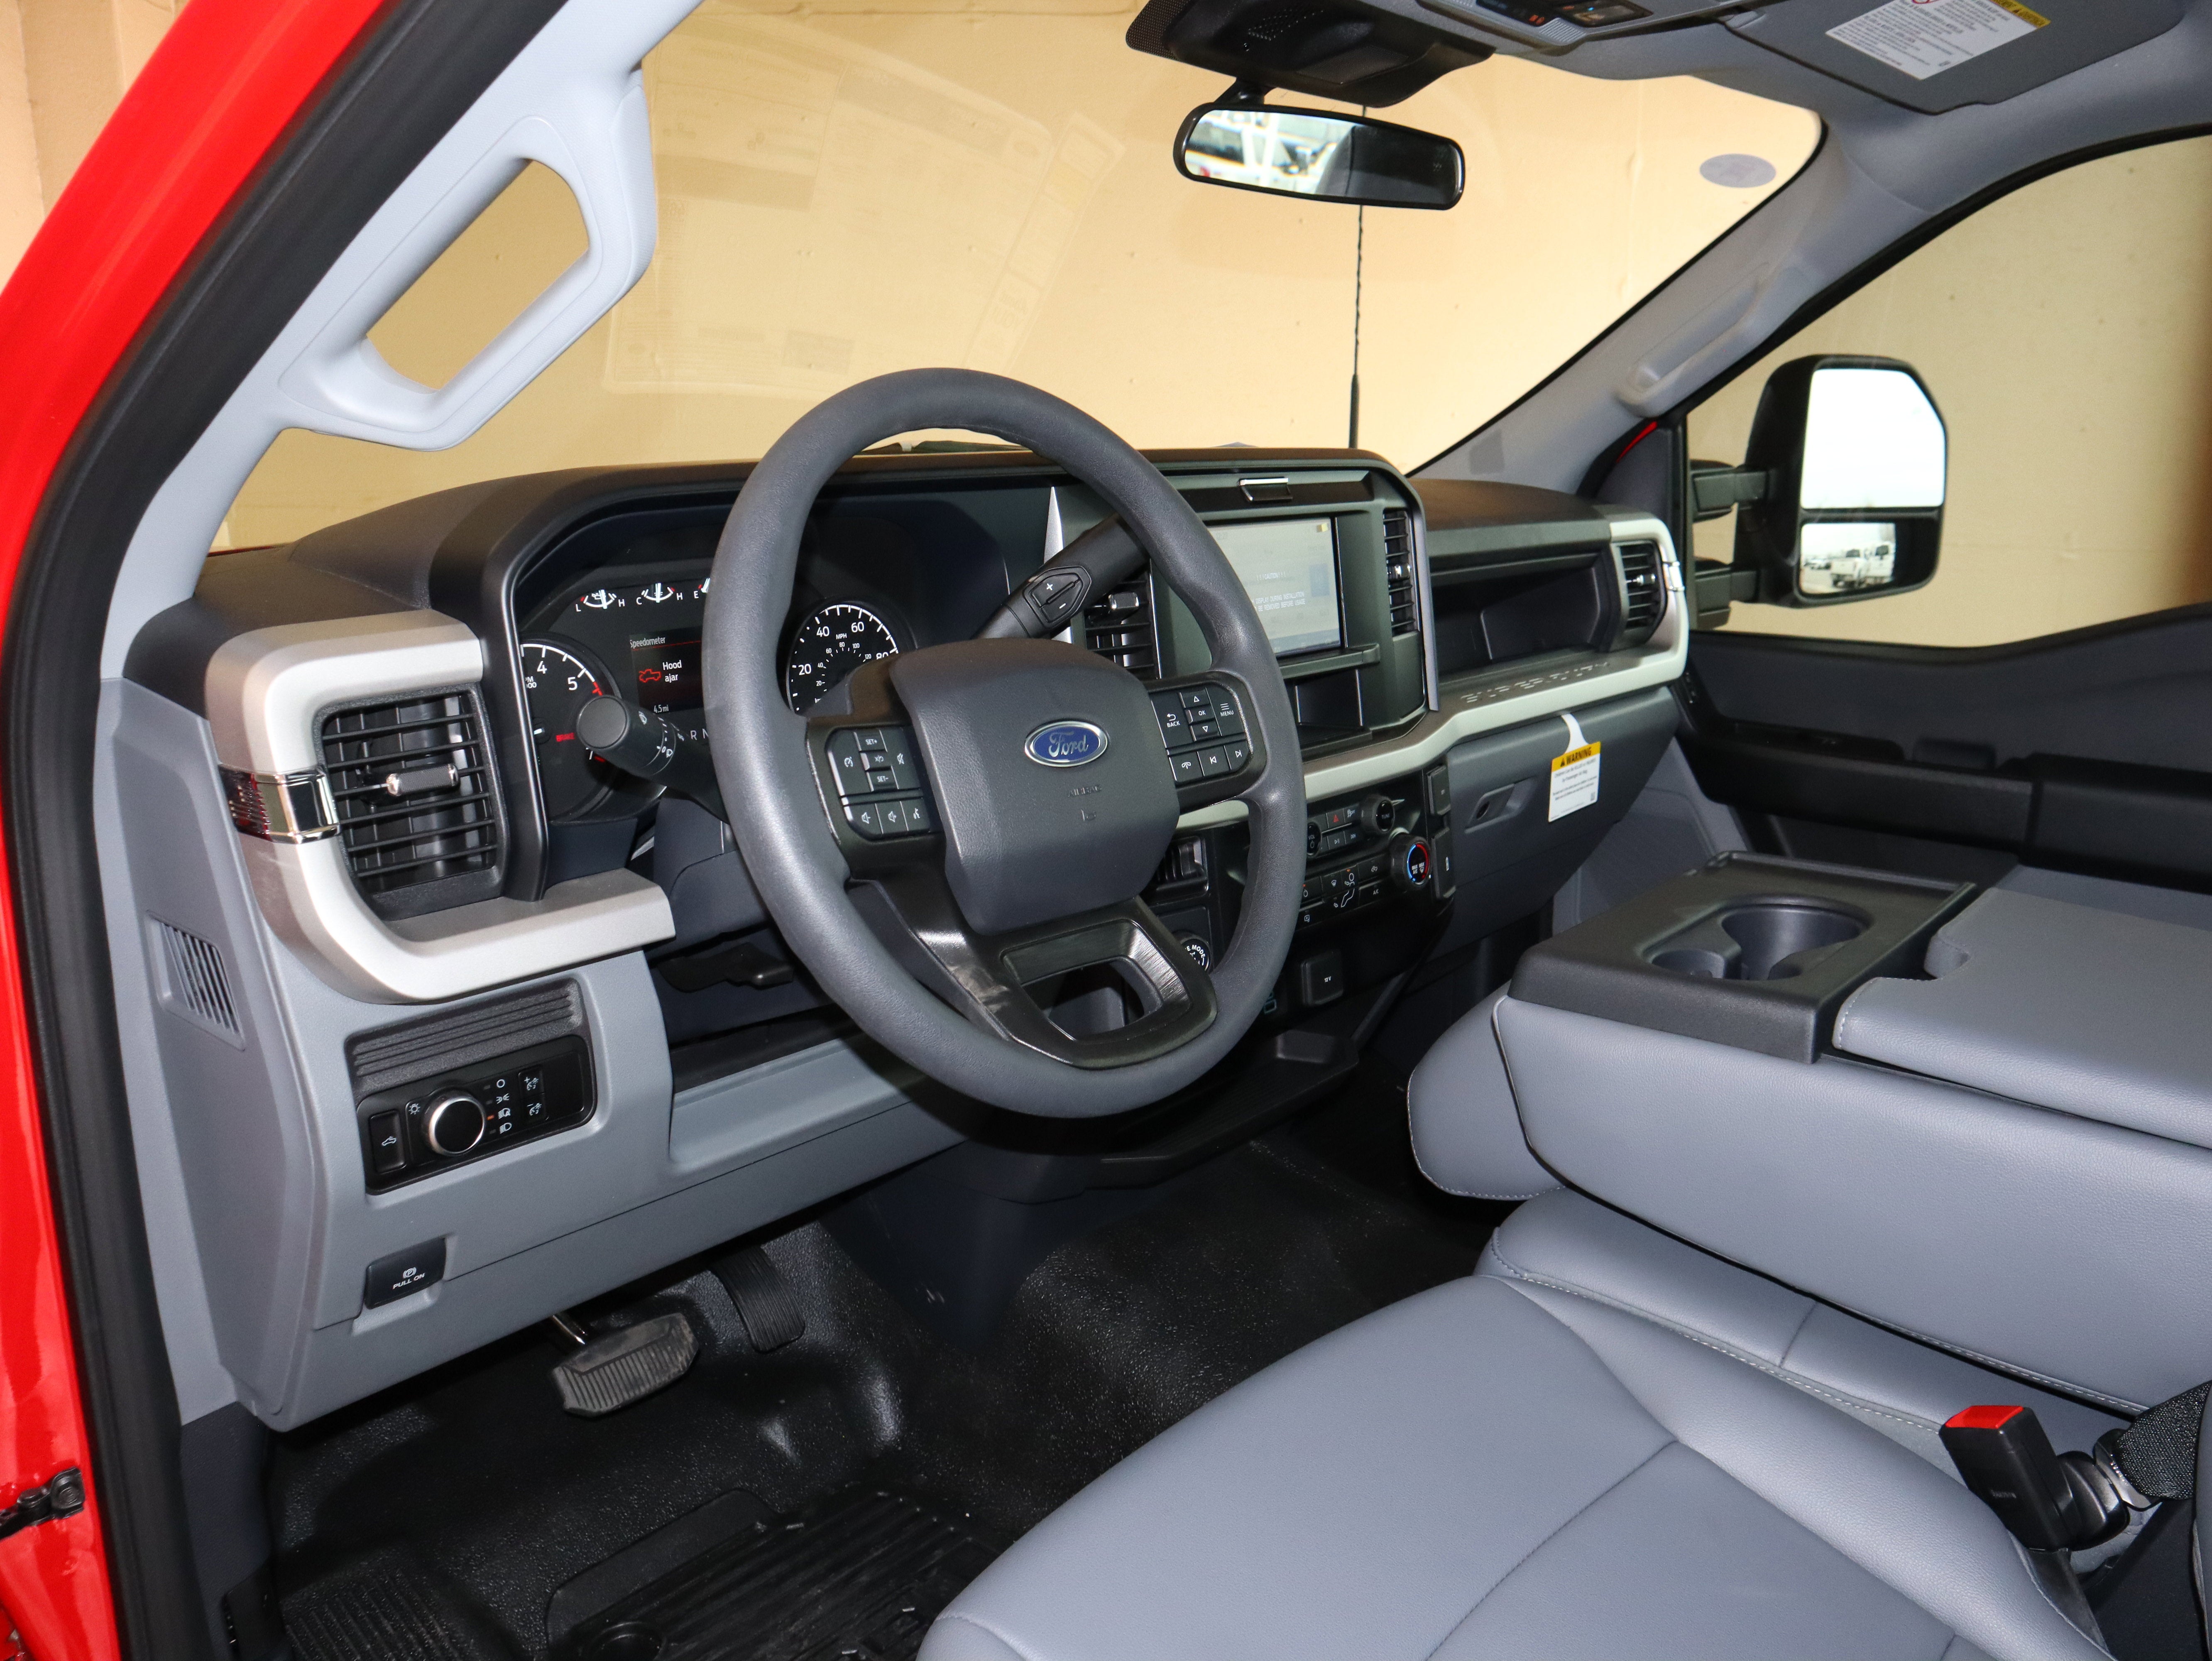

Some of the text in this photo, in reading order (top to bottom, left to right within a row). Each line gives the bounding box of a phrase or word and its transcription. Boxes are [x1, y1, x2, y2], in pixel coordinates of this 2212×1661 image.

[693, 590, 699, 599] E
[618, 599, 625, 607] H
[636, 597, 642, 605] C
[575, 604, 581, 612] L
[816, 626, 830, 637] 40
[851, 621, 864, 632] 60
[630, 636, 666, 649] Speedometer
[537, 661, 547, 674] 4
[663, 659, 682, 671] Hood
[798, 664, 812, 675] 20
[567, 676, 577, 691] 5
[665, 674, 678, 683] ajar
[690, 730, 697, 740] R
[1048, 731, 1089, 757] Ford
[1566, 747, 1592, 765] WARNING
[1191, 944, 1206, 958] MODE
[392, 1273, 425, 1290] PULL ON
